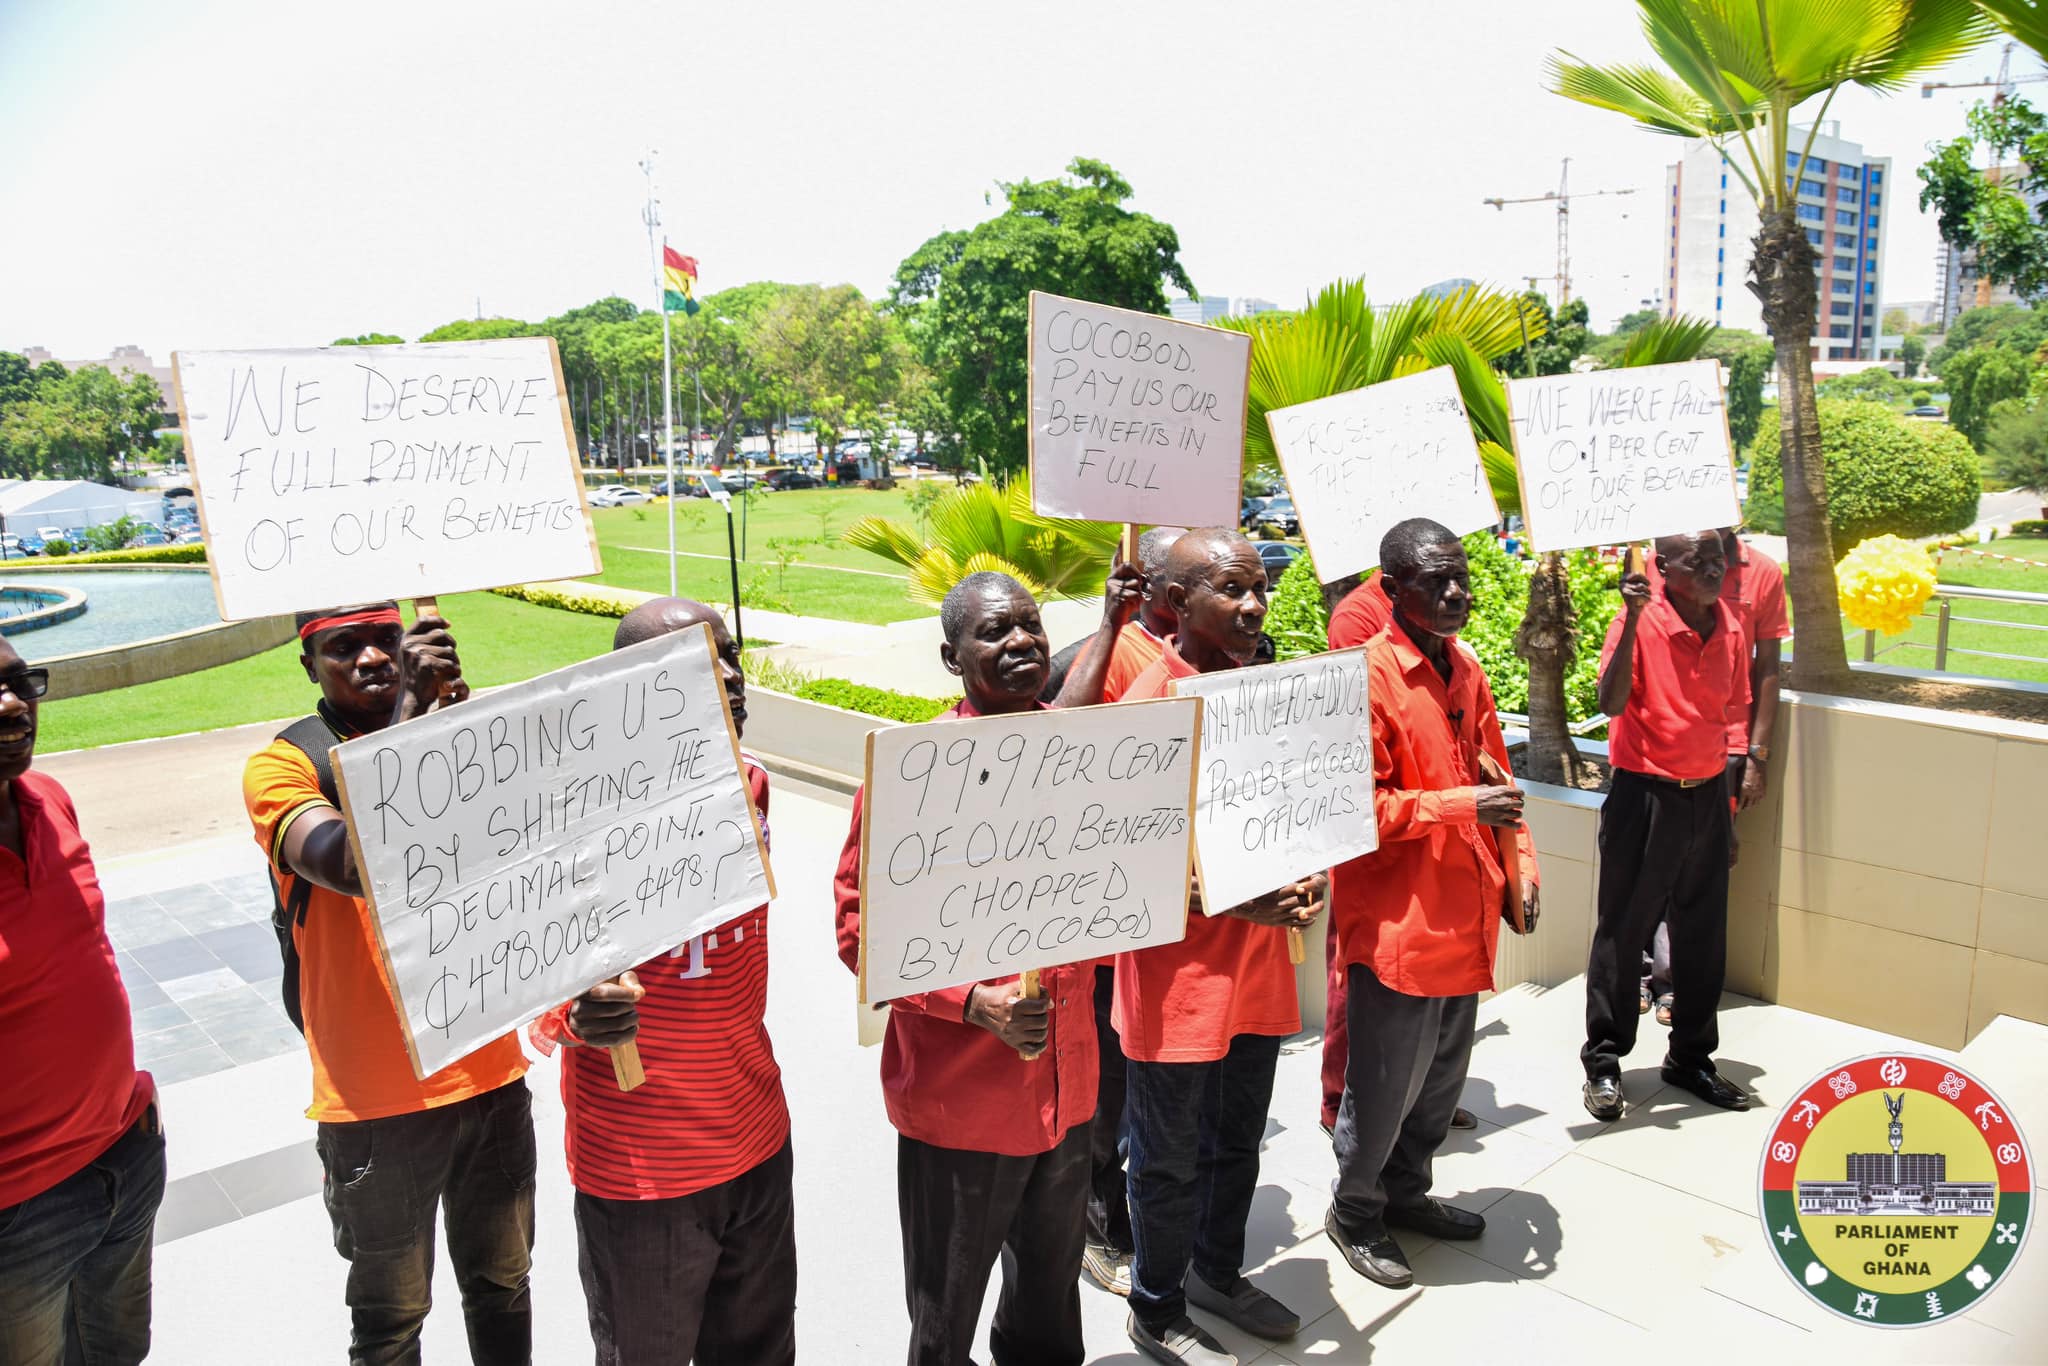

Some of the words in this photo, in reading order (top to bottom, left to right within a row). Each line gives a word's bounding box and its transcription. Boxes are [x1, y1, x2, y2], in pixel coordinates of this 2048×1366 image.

[224, 365, 320, 440] WE
[355, 364, 546, 422] DESERVE
[1050, 358, 1123, 406] PAY
[1131, 377, 1163, 406] US
[1171, 383, 1222, 421] OUR
[1526, 386, 1573, 436] WE
[1588, 386, 1664, 426] WERE
[1047, 400, 1170, 446] BENEFITS
[1179, 426, 1206, 456] IN
[1548, 435, 1598, 473] 0.1
[1608, 434, 1648, 461] PER
[1654, 430, 1704, 458] CENT
[230, 447, 349, 502] FULL
[367, 440, 542, 485] PAYMENT
[1078, 449, 1160, 489] FULL
[1540, 478, 1574, 509] OF
[245, 518, 304, 571] OF
[331, 505, 424, 555] OUR
[442, 497, 574, 540] BENEFITS
[1574, 503, 1636, 534] WHY
[372, 698, 598, 844] ROBBING
[623, 671, 686, 740] US
[900, 733, 1027, 817] 99.9
[1032, 735, 1096, 789] PER
[1108, 735, 1188, 780] CENT
[1206, 758, 1295, 824] PROBE
[1304, 735, 1370, 788] COCOBOD
[403, 832, 461, 908] BY
[487, 760, 655, 857] SHIFTING
[667, 728, 711, 791] THE
[888, 825, 953, 886] OF
[966, 815, 1057, 867] OUR
[1069, 803, 1185, 855] BENEFITS
[1242, 784, 1360, 851] OFFICIALS.
[421, 853, 587, 958] DECIMAL
[939, 860, 1128, 928] CHOPPED
[899, 936, 964, 980] BY
[987, 898, 1151, 964] COCOBOD
